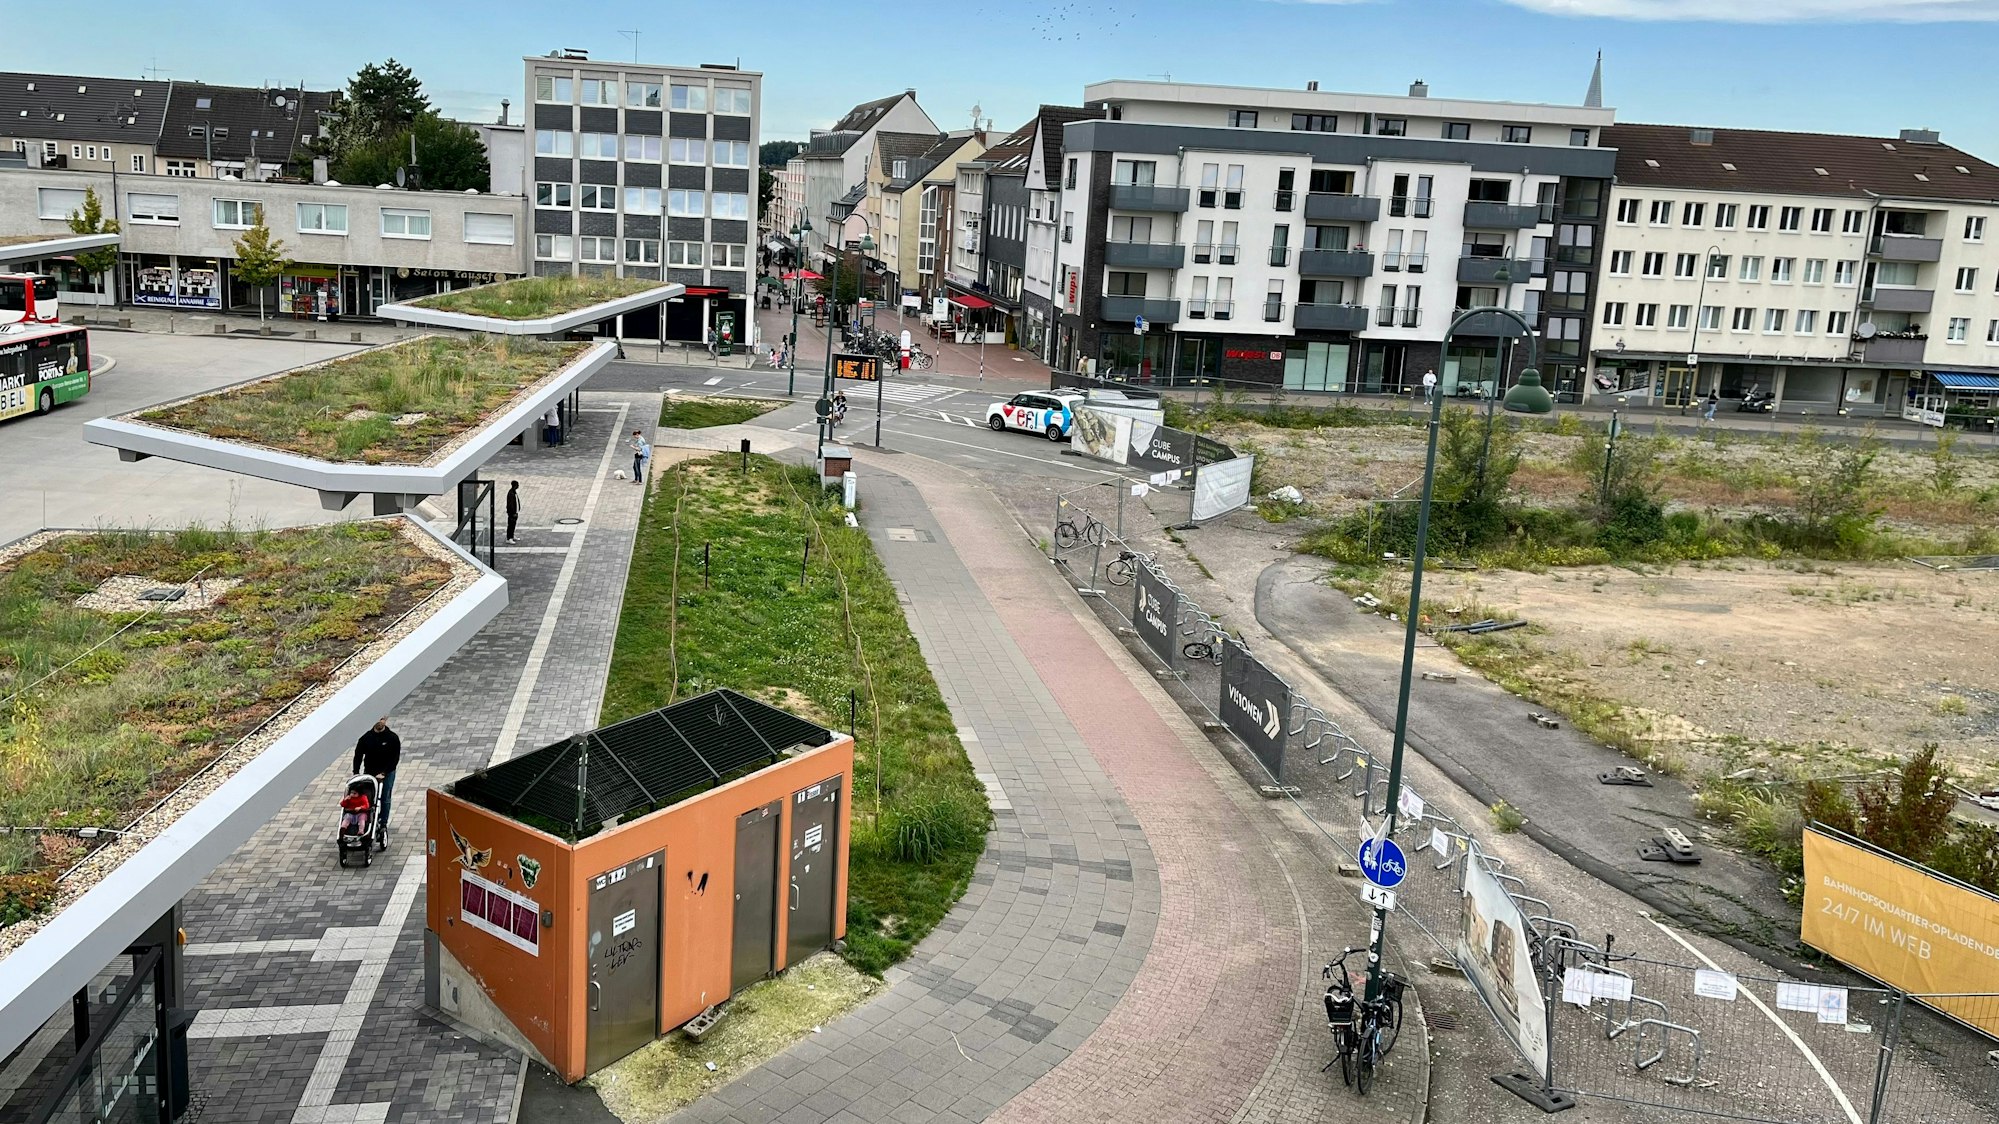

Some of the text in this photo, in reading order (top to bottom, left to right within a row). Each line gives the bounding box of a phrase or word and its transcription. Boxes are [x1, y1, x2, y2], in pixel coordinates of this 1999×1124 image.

[413, 268, 449, 278] Salon
[1068, 271, 1077, 304] wupsi
[38, 366, 64, 381] PORTAS
[1152, 438, 1171, 452] CUBE
[1151, 449, 1181, 465] CAMPUS
[1147, 593, 1161, 615] CUBE
[1145, 609, 1168, 637] CAMPUS
[1228, 683, 1263, 726] VISIONEN
[596, 878, 607, 887] WC
[1821, 897, 1931, 960] 24/7 IM WEB
